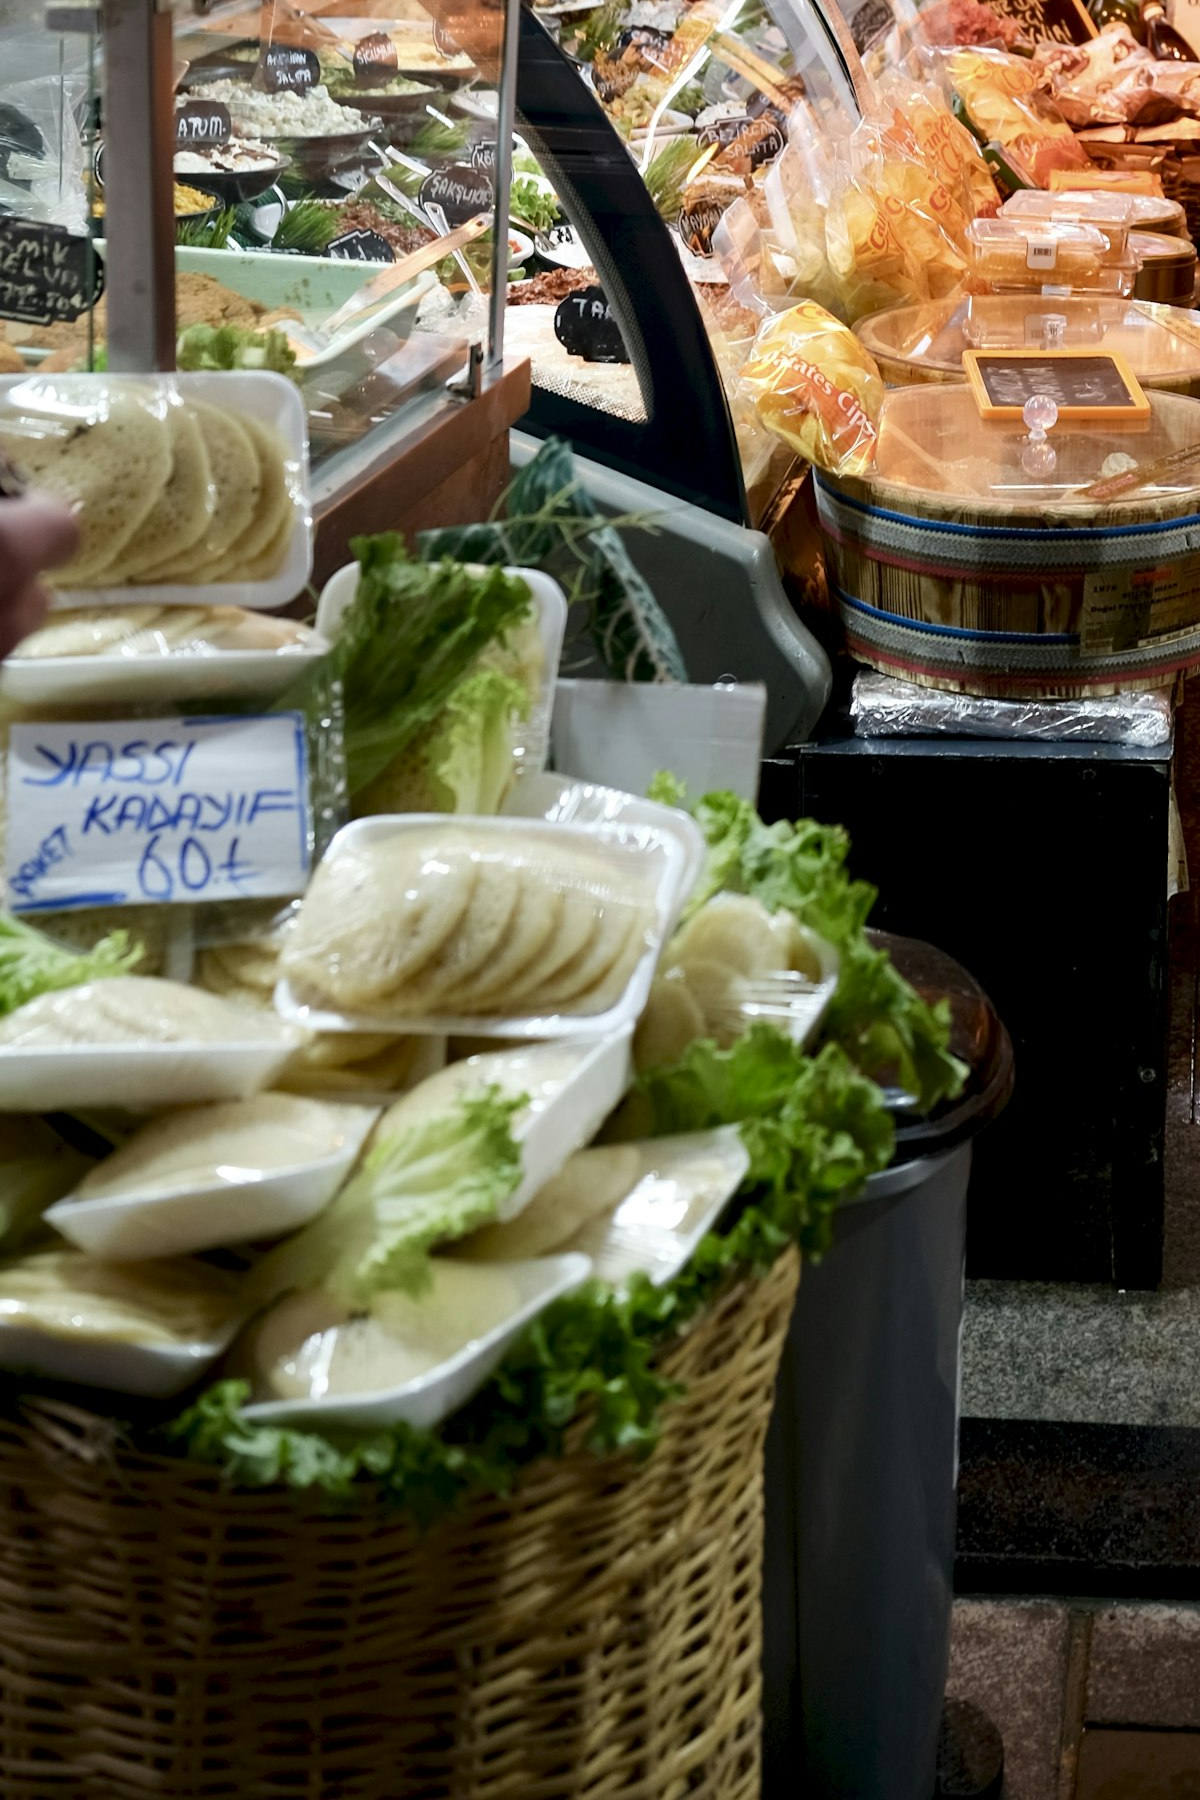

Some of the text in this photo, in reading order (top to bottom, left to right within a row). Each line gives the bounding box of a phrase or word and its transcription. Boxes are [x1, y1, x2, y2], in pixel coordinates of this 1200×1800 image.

[725, 136, 779, 158] SALATA
[22, 740, 197, 788] YASSI
[82, 790, 294, 835] KADAYIF
